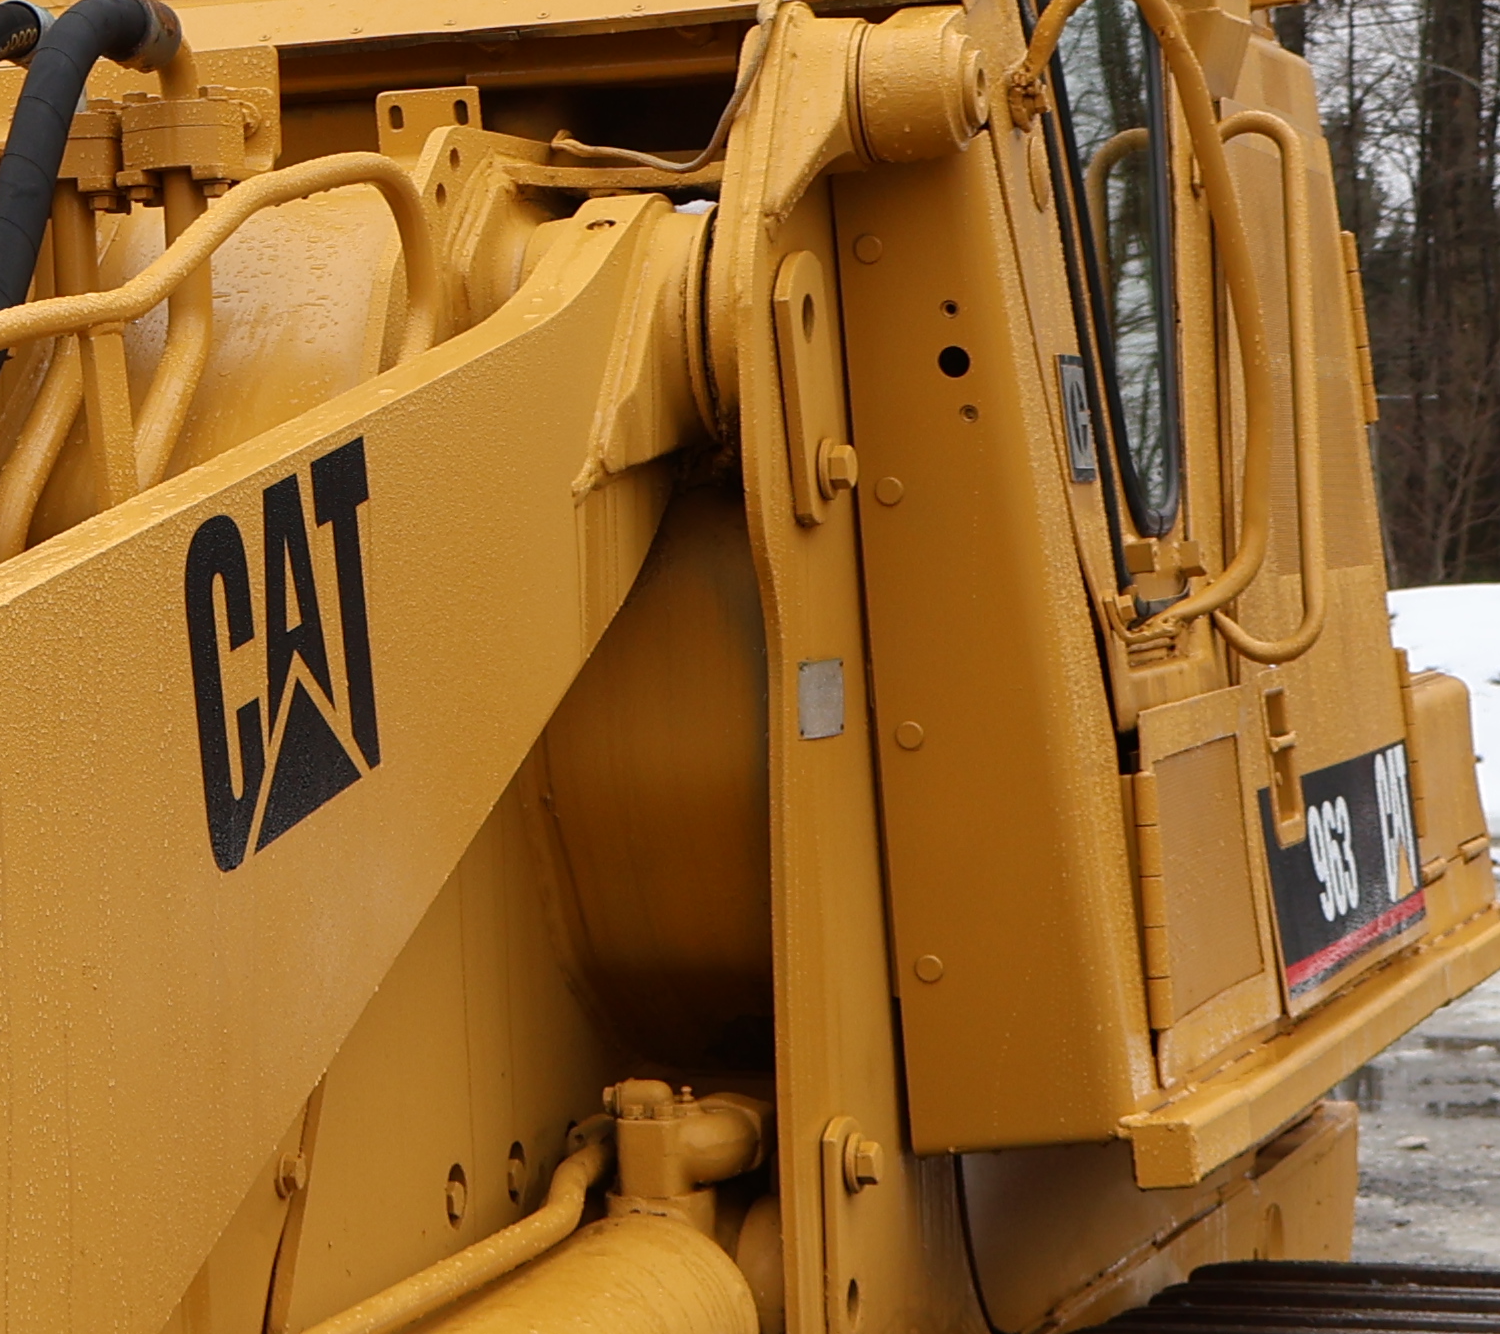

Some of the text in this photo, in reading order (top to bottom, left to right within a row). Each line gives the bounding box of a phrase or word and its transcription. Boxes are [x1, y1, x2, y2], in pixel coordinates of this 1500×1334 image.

[185, 435, 381, 873] CAT
[1307, 743, 1421, 922] 963 CAT
